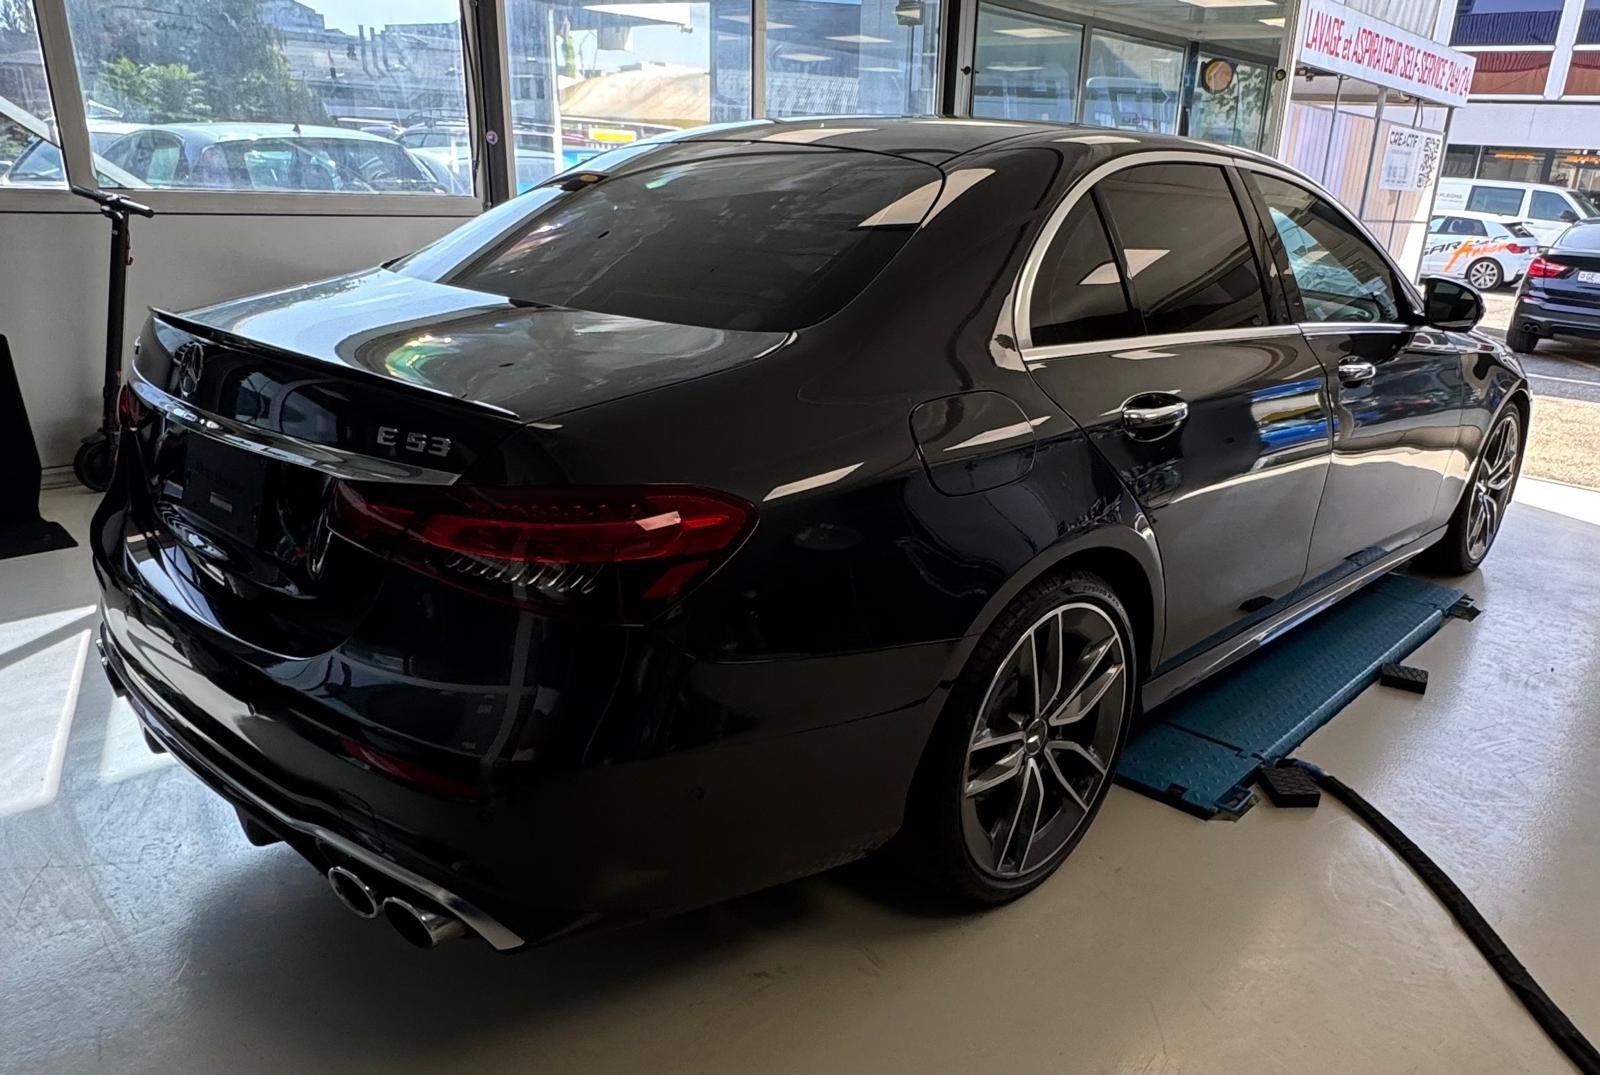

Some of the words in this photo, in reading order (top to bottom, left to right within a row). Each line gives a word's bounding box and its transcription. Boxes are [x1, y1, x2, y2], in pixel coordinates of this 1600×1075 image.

[1306, 9, 1345, 57] LAVAGE
[1341, 34, 1353, 61] et
[1351, 27, 1403, 77] ASPIRATEUR
[1399, 44, 1449, 90] SELF-SERVICE
[376, 425, 399, 446] E
[405, 431, 452, 457] 53
